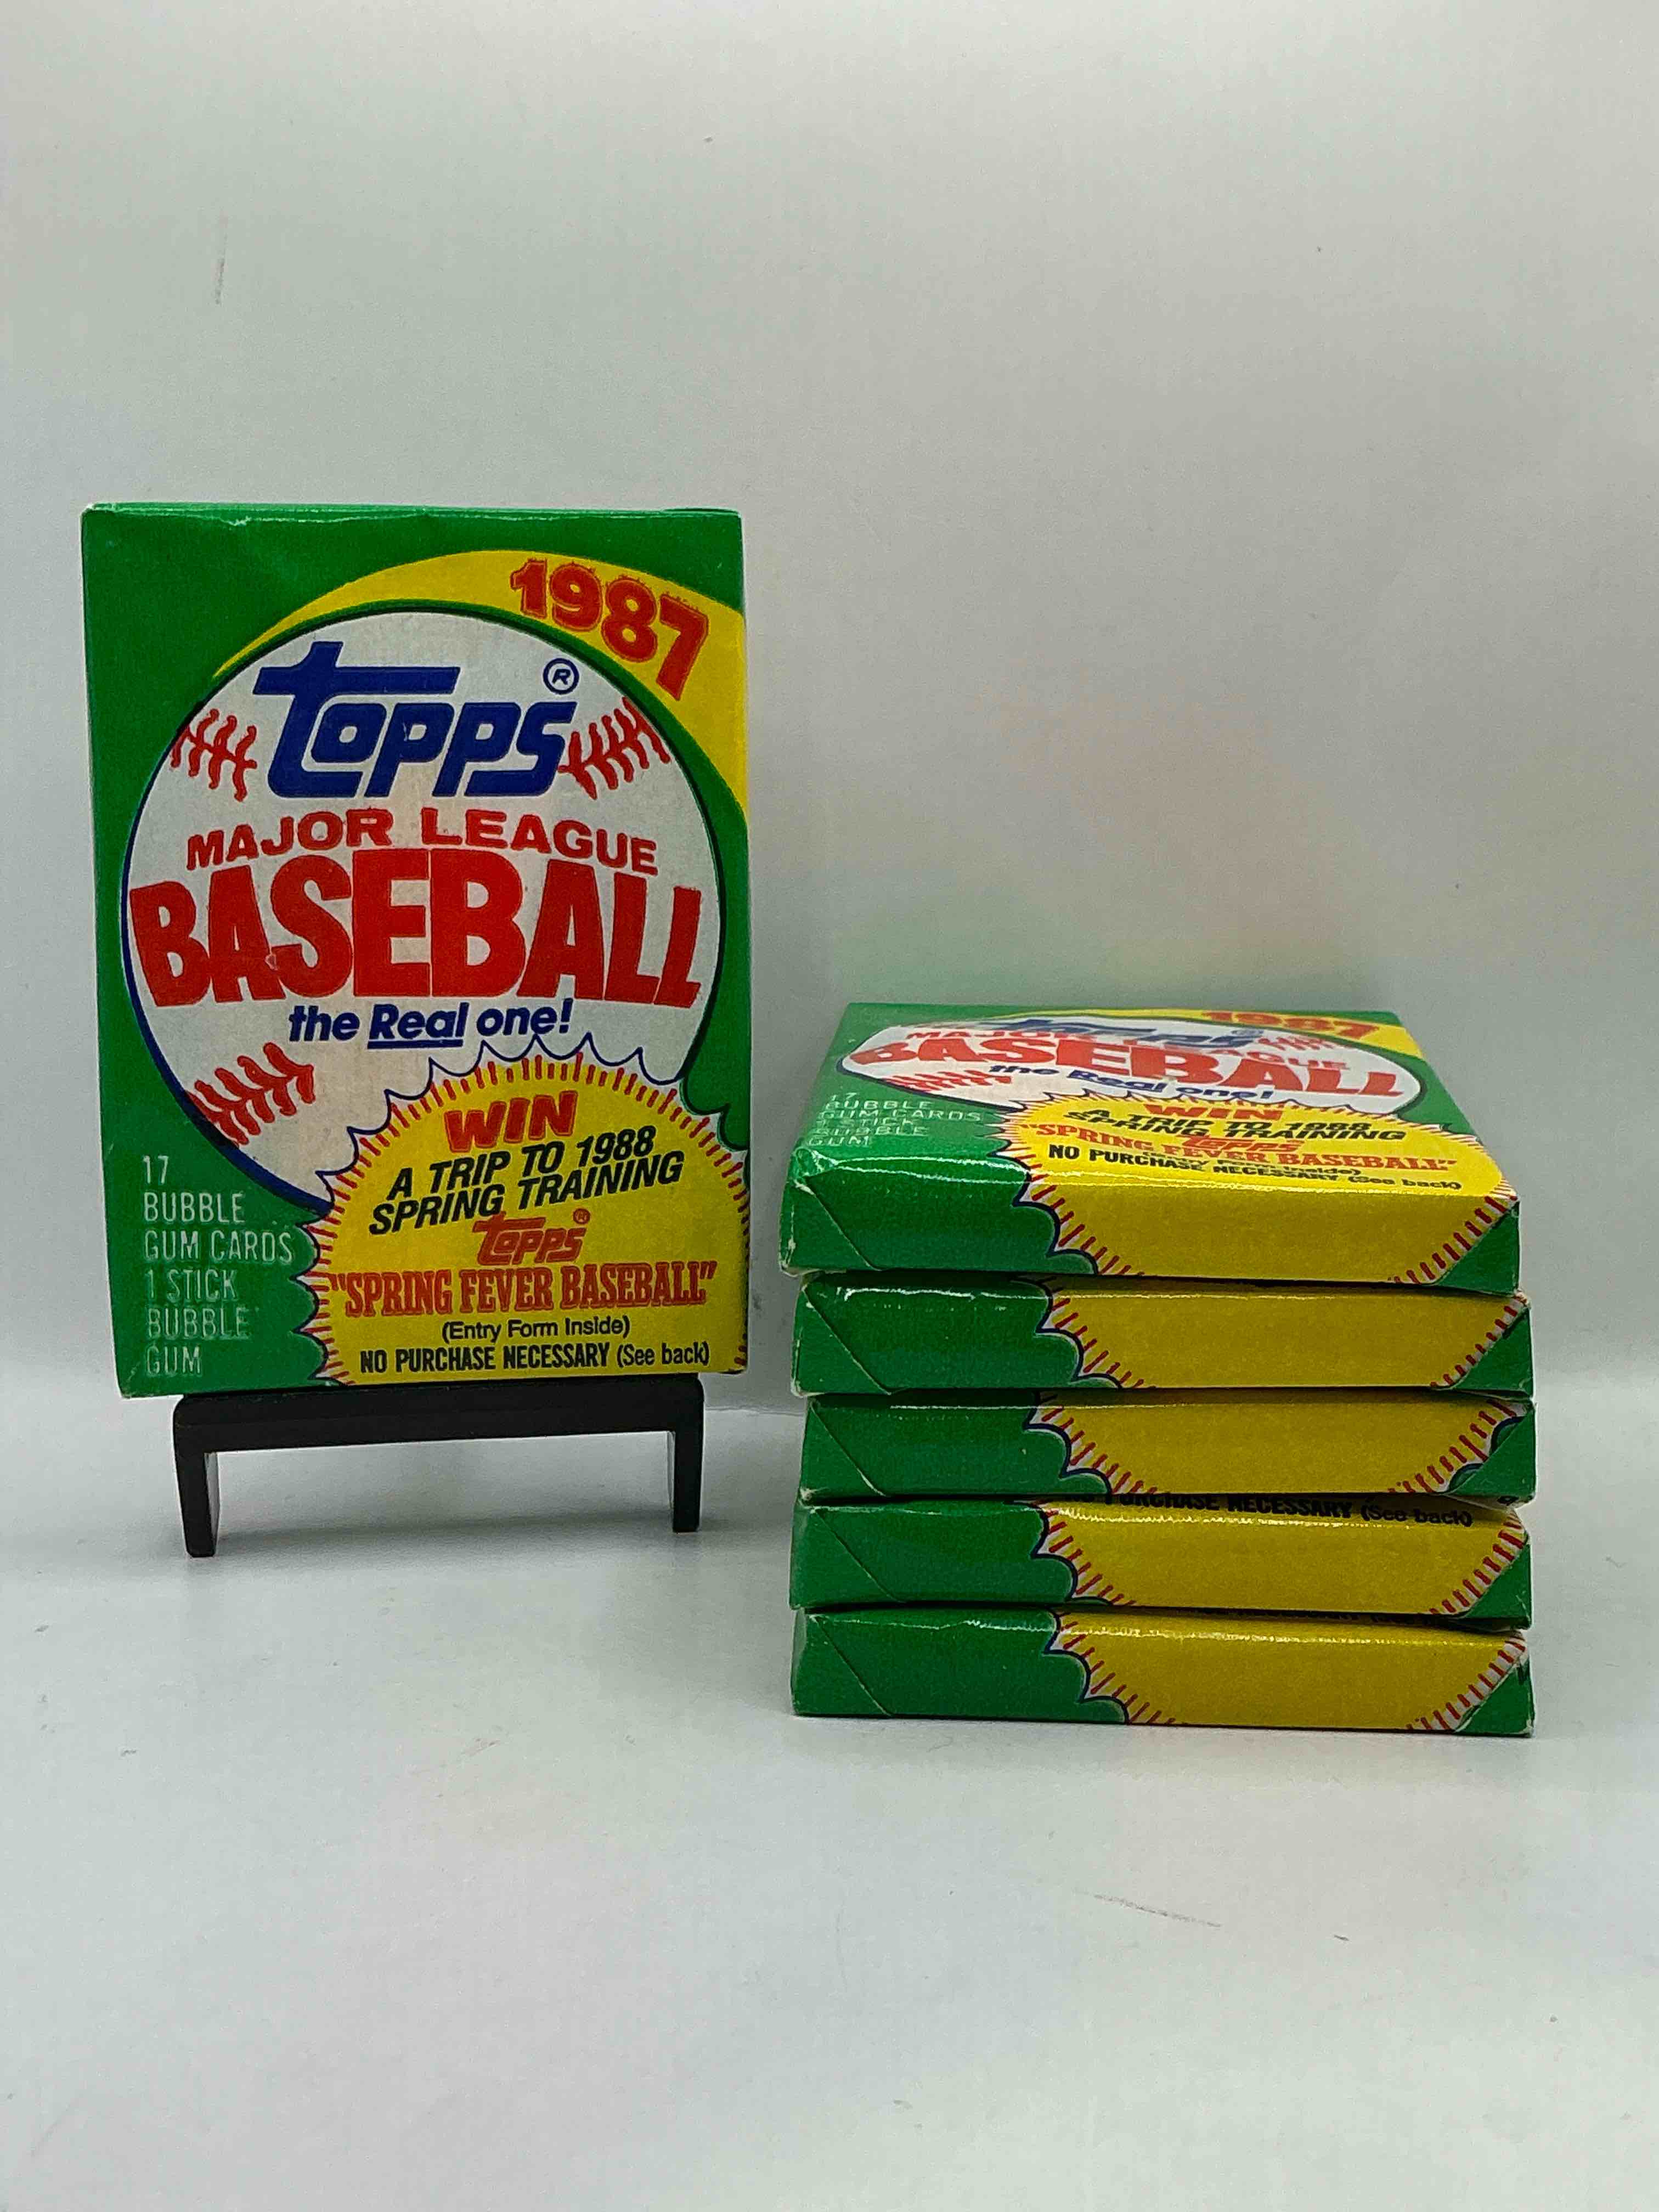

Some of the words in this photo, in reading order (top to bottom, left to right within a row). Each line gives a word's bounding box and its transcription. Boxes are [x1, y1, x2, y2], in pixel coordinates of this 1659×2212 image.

[510, 559, 708, 701] 1987
[187, 808, 394, 871] MAJOR
[421, 809, 658, 875] LEAGUE
[130, 849, 702, 1007] BASEBALL
[289, 1005, 360, 1041] the
[368, 1002, 469, 1041] Real
[477, 998, 574, 1036] one!
[850, 1037, 1403, 1097] BASEBALL
[444, 1090, 579, 1153] WIN
[891, 1109, 984, 1121] CARDS
[1063, 1111, 1211, 1137] SPRING
[1223, 1129, 1407, 1141] TRAINING
[1126, 1113, 1215, 1128] TRIP
[1143, 1103, 1284, 1120] WIN
[142, 1155, 170, 1185] 17
[386, 1167, 413, 1200] A
[430, 1150, 511, 1194] TRIP
[522, 1140, 565, 1177] TO
[577, 1125, 657, 1166] 1988
[1048, 1144, 1080, 1160] NO
[1089, 1148, 1206, 1171] PURCHASE
[1276, 1153, 1458, 1171] BASEBALL"
[143, 1192, 246, 1223] BUBBLE
[369, 1184, 505, 1235] SPRING
[518, 1150, 685, 1210] TRAINING
[144, 1230, 200, 1260] GUM
[211, 1230, 294, 1264] CARDS
[146, 1268, 156, 1300] 1
[166, 1268, 238, 1303] STICK
[331, 1269, 452, 1317] "SPRING
[460, 1265, 554, 1314] FEVER
[560, 1260, 717, 1310] BASEBALL"
[148, 1307, 251, 1340] BUBBLE
[442, 1320, 501, 1343] (Entry
[507, 1319, 559, 1338] Form
[565, 1315, 630, 1338] Inside)
[146, 1344, 202, 1377] GUM
[360, 1350, 388, 1373] NO
[396, 1346, 495, 1373] PURCHASE
[503, 1342, 610, 1369] NECESSARY
[617, 1343, 655, 1368] (See
[662, 1342, 710, 1367] back)
